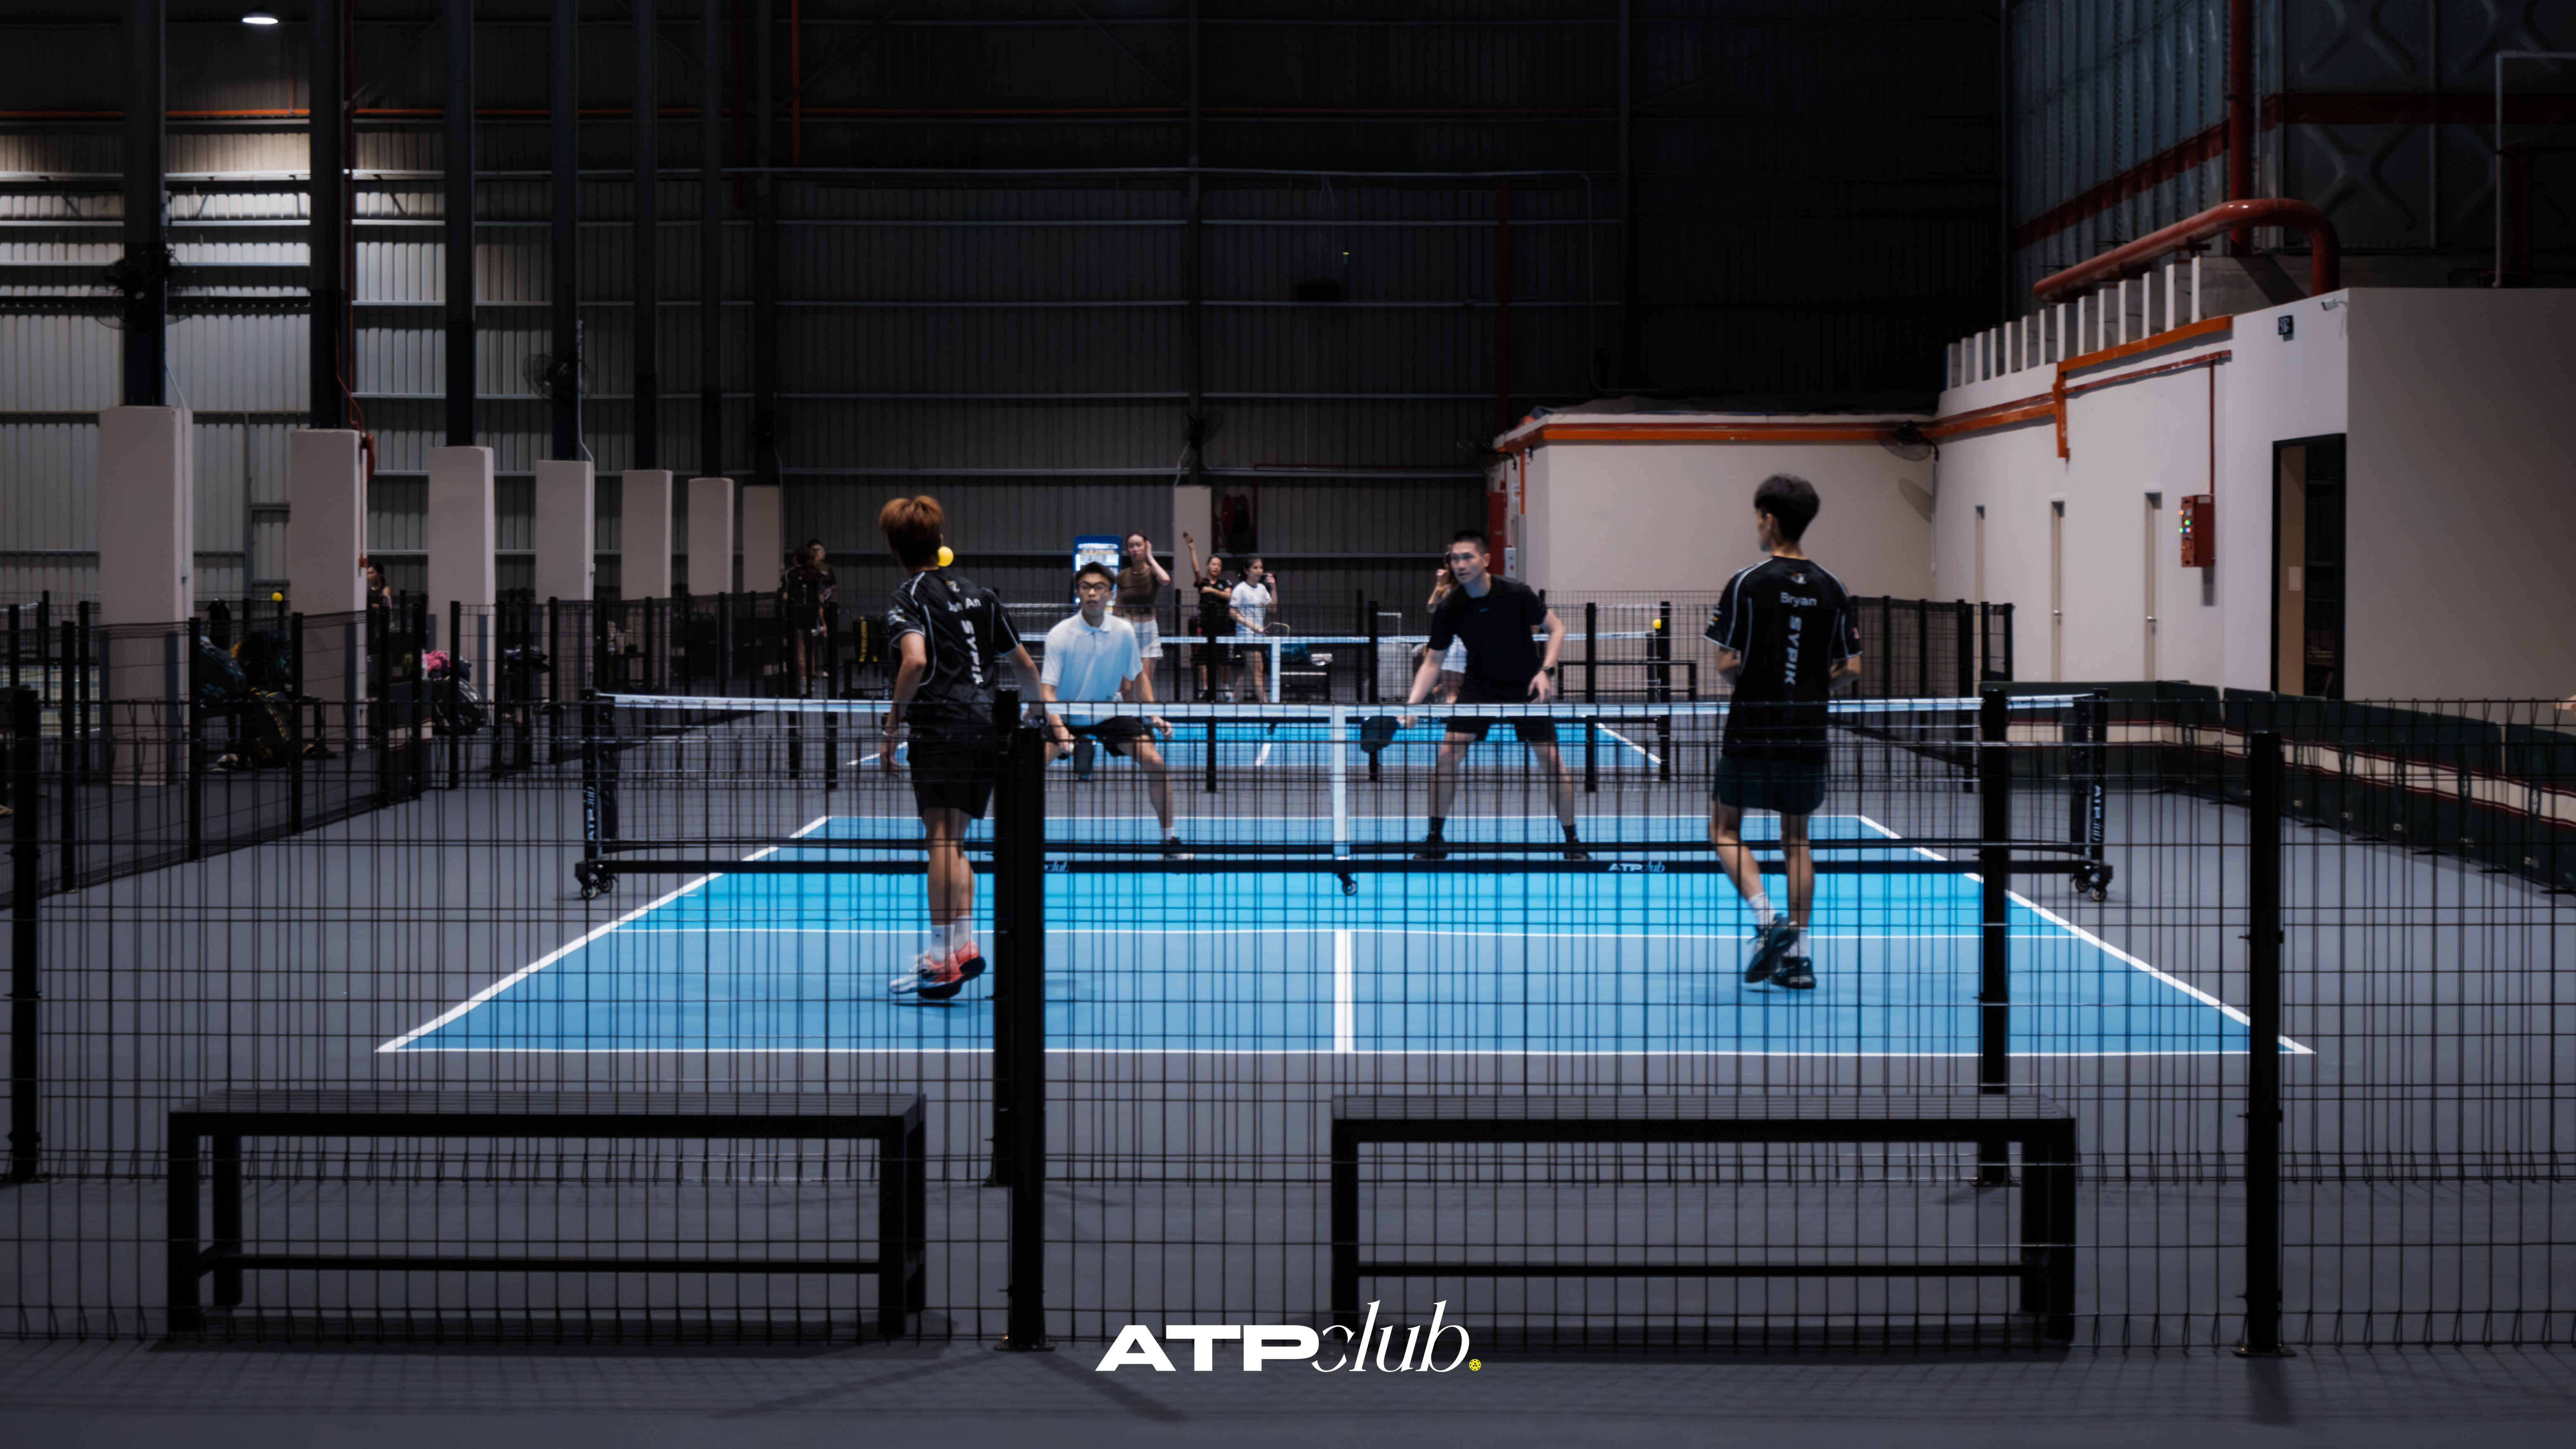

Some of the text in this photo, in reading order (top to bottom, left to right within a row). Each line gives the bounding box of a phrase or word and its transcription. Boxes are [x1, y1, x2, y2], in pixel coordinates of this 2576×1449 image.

[965, 597, 982, 609] An
[1779, 591, 1818, 608] Bryan
[1783, 614, 1802, 686] SYPIK
